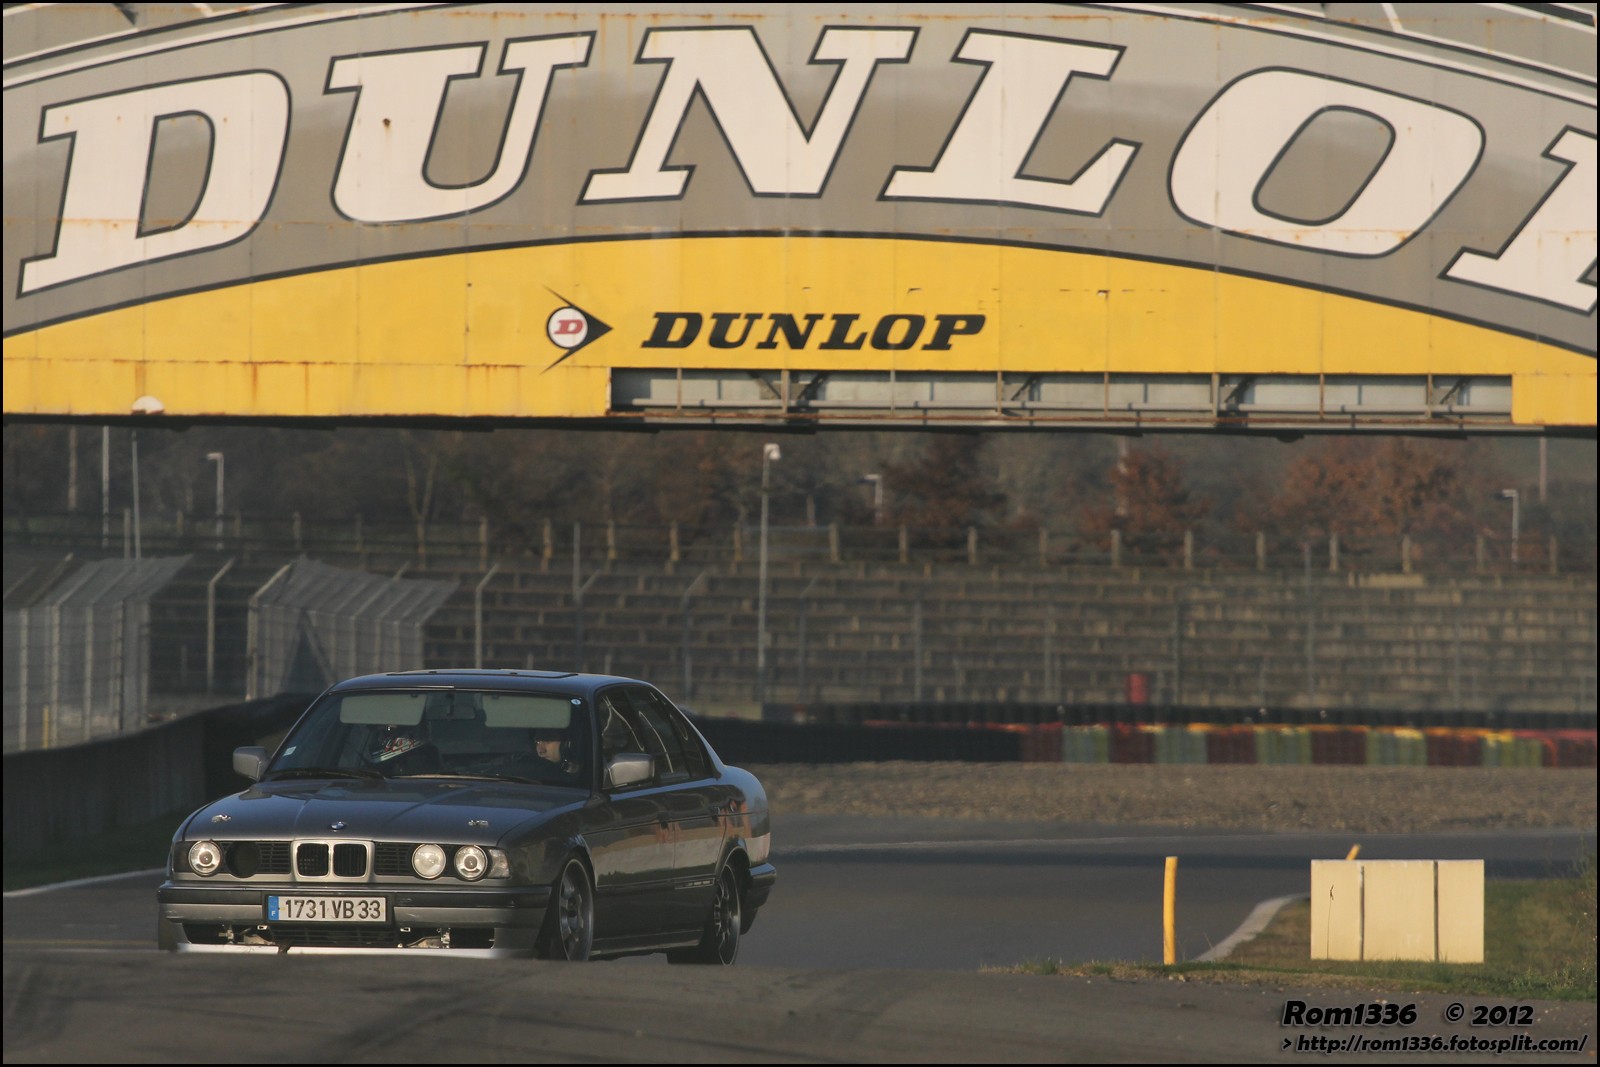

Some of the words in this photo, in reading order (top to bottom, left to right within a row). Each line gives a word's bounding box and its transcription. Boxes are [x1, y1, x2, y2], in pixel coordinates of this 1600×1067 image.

[554, 319, 584, 335] D
[641, 311, 987, 351] DUNLOP
[285, 899, 326, 919] 1731
[331, 900, 355, 919] VB
[358, 900, 381, 919] 33
